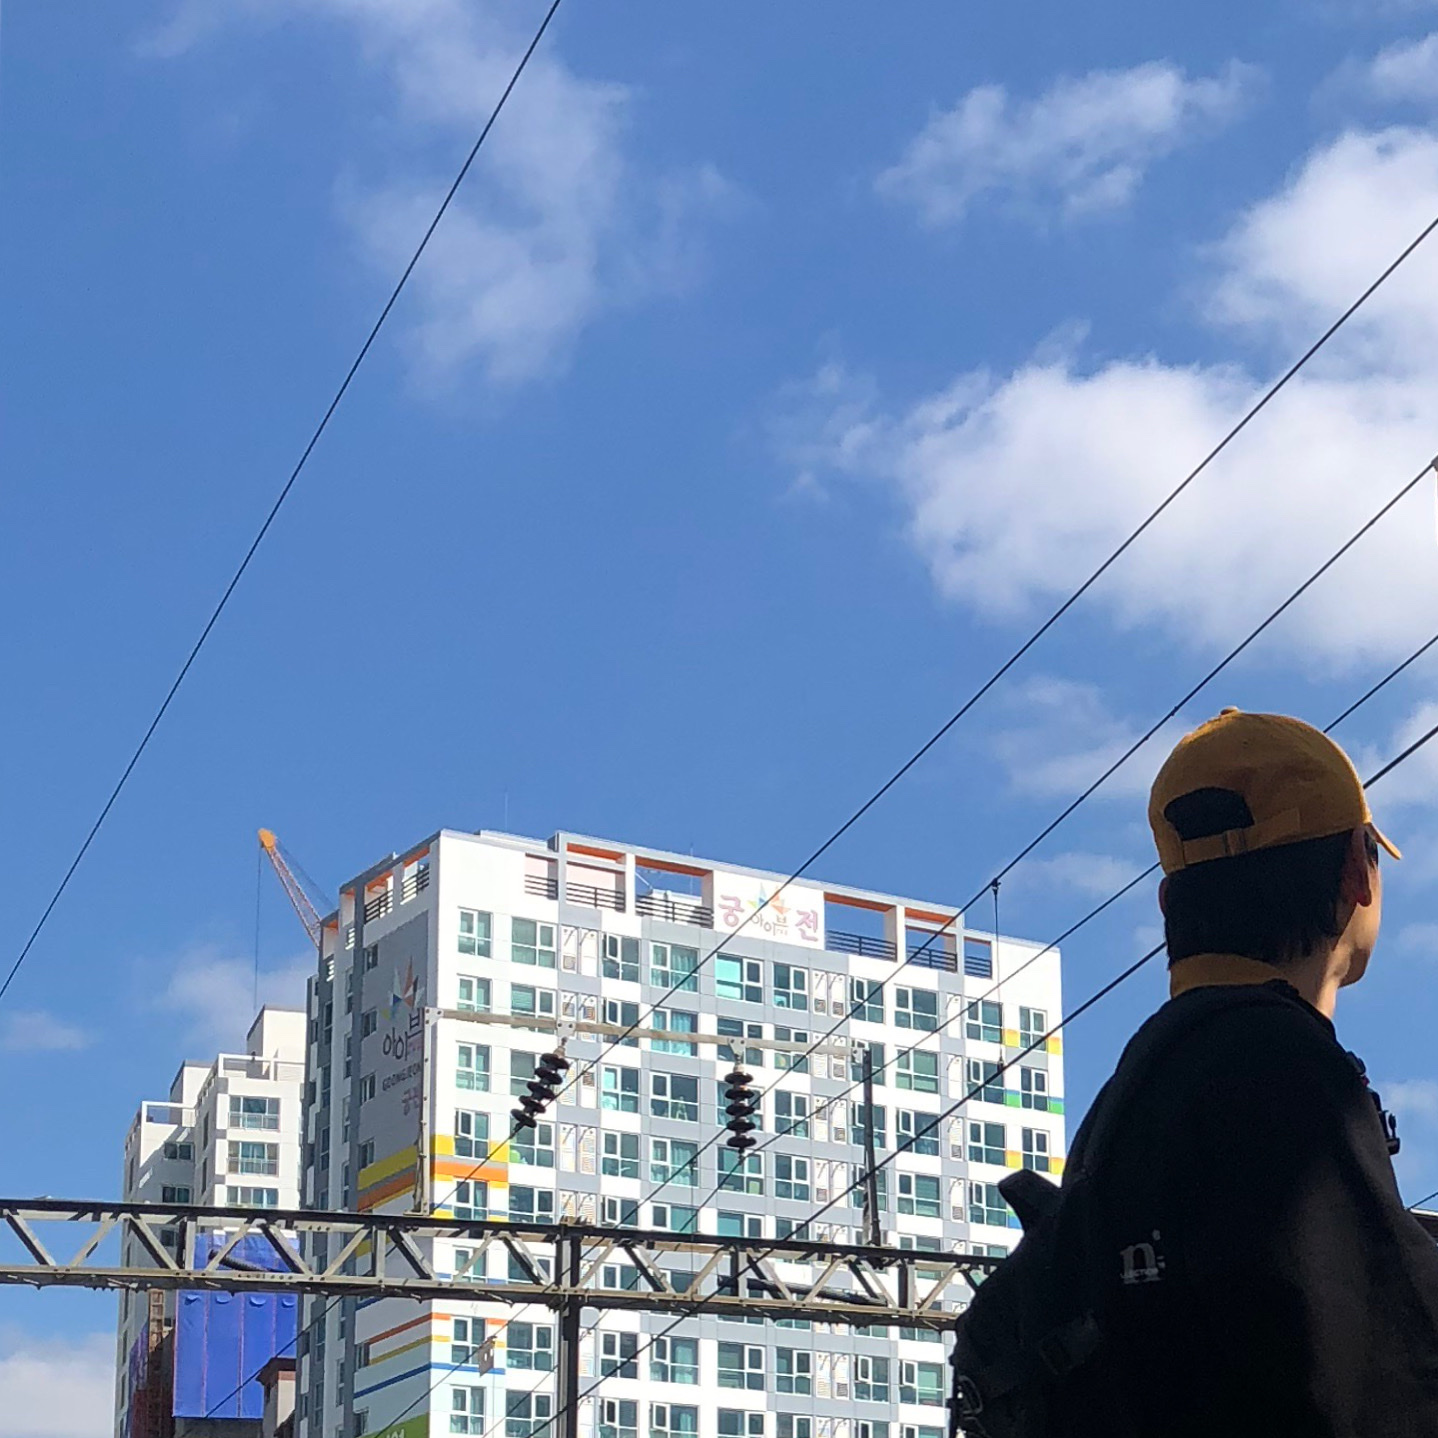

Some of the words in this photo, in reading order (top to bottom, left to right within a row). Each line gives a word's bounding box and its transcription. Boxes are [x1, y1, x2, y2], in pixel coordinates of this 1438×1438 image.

[718, 894, 745, 927] 궁
[750, 914, 789, 936] 아이브
[795, 909, 819, 942] 전
